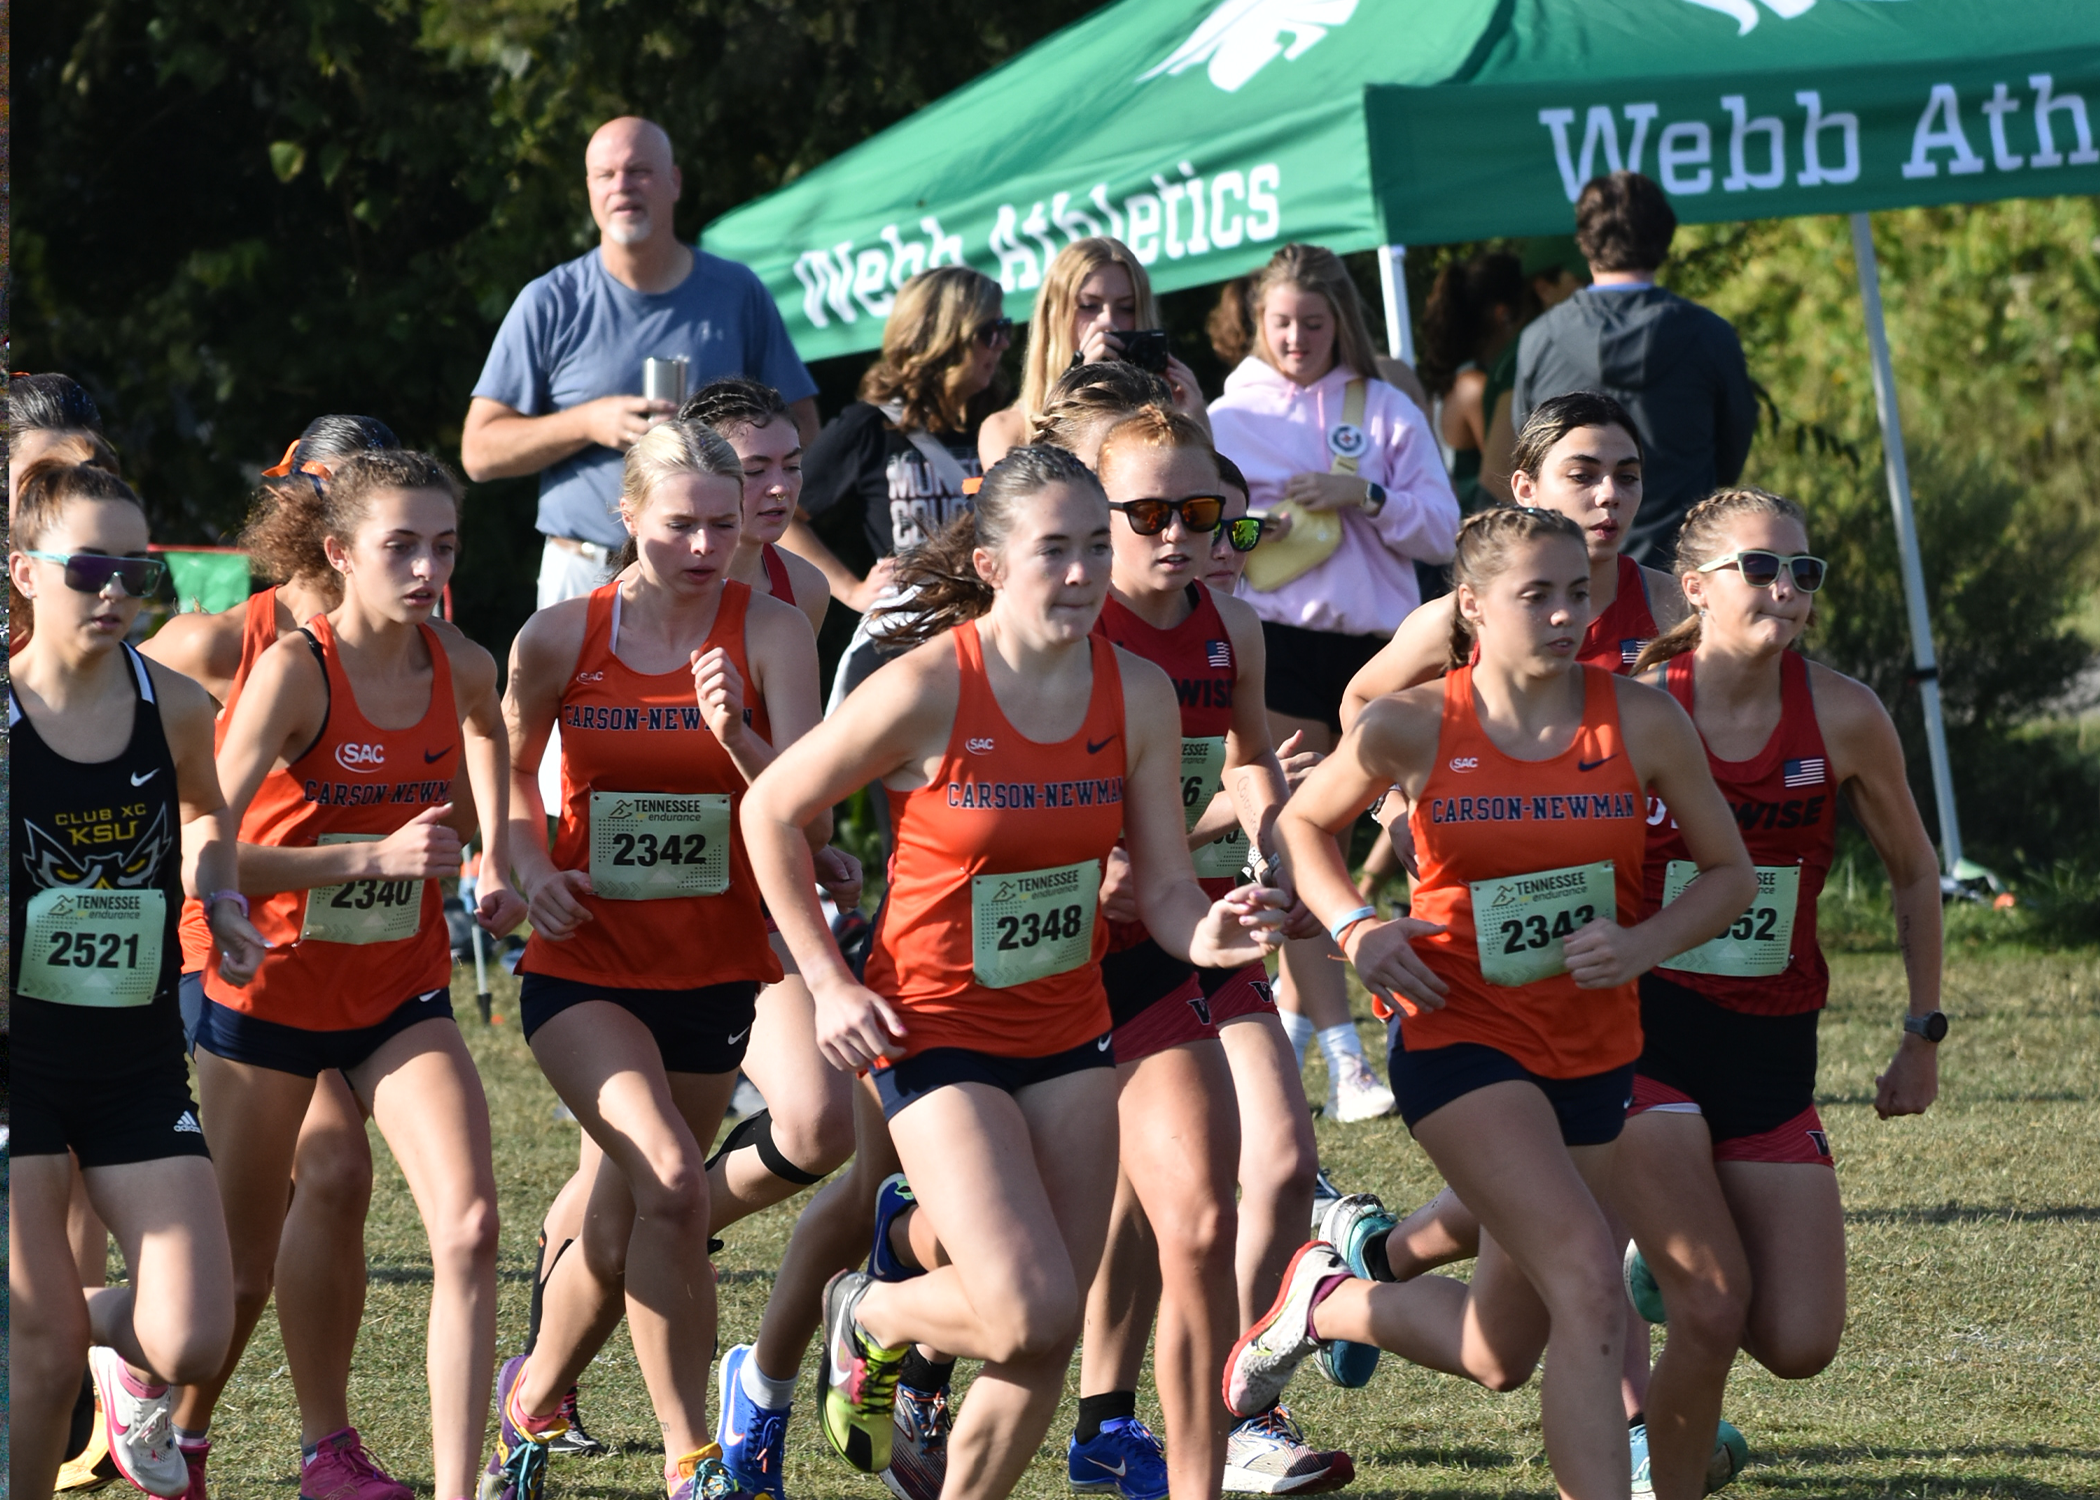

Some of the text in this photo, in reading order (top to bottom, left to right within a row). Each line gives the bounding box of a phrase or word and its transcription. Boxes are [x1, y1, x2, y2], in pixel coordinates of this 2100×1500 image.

[1539, 91, 1861, 203] Webb
[989, 160, 1280, 294] Athletics
[580, 671, 604, 682] SAC
[343, 743, 385, 763] SAC
[969, 738, 994, 750] SAC
[1453, 757, 1478, 769] SAC
[303, 779, 451, 807] CARSON-NEWM
[55, 803, 148, 826] CLUB XC
[635, 799, 701, 814] TENNESSEE
[648, 812, 702, 822] endurance
[1432, 793, 1635, 824] CARSON-NEWMAN
[1730, 795, 1827, 831] WISE
[66, 820, 139, 846] KSU
[613, 833, 707, 867] 2342
[1017, 869, 1080, 892] TENNESSEE
[1515, 871, 1586, 896] TENNESSEE
[75, 895, 141, 911] TENNESSEE
[330, 879, 414, 910] 2340
[1031, 884, 1080, 901] endurance
[1532, 885, 1588, 903] endurance
[88, 910, 141, 920] endurance
[997, 905, 1082, 951] 2348
[47, 931, 139, 969] 2521
